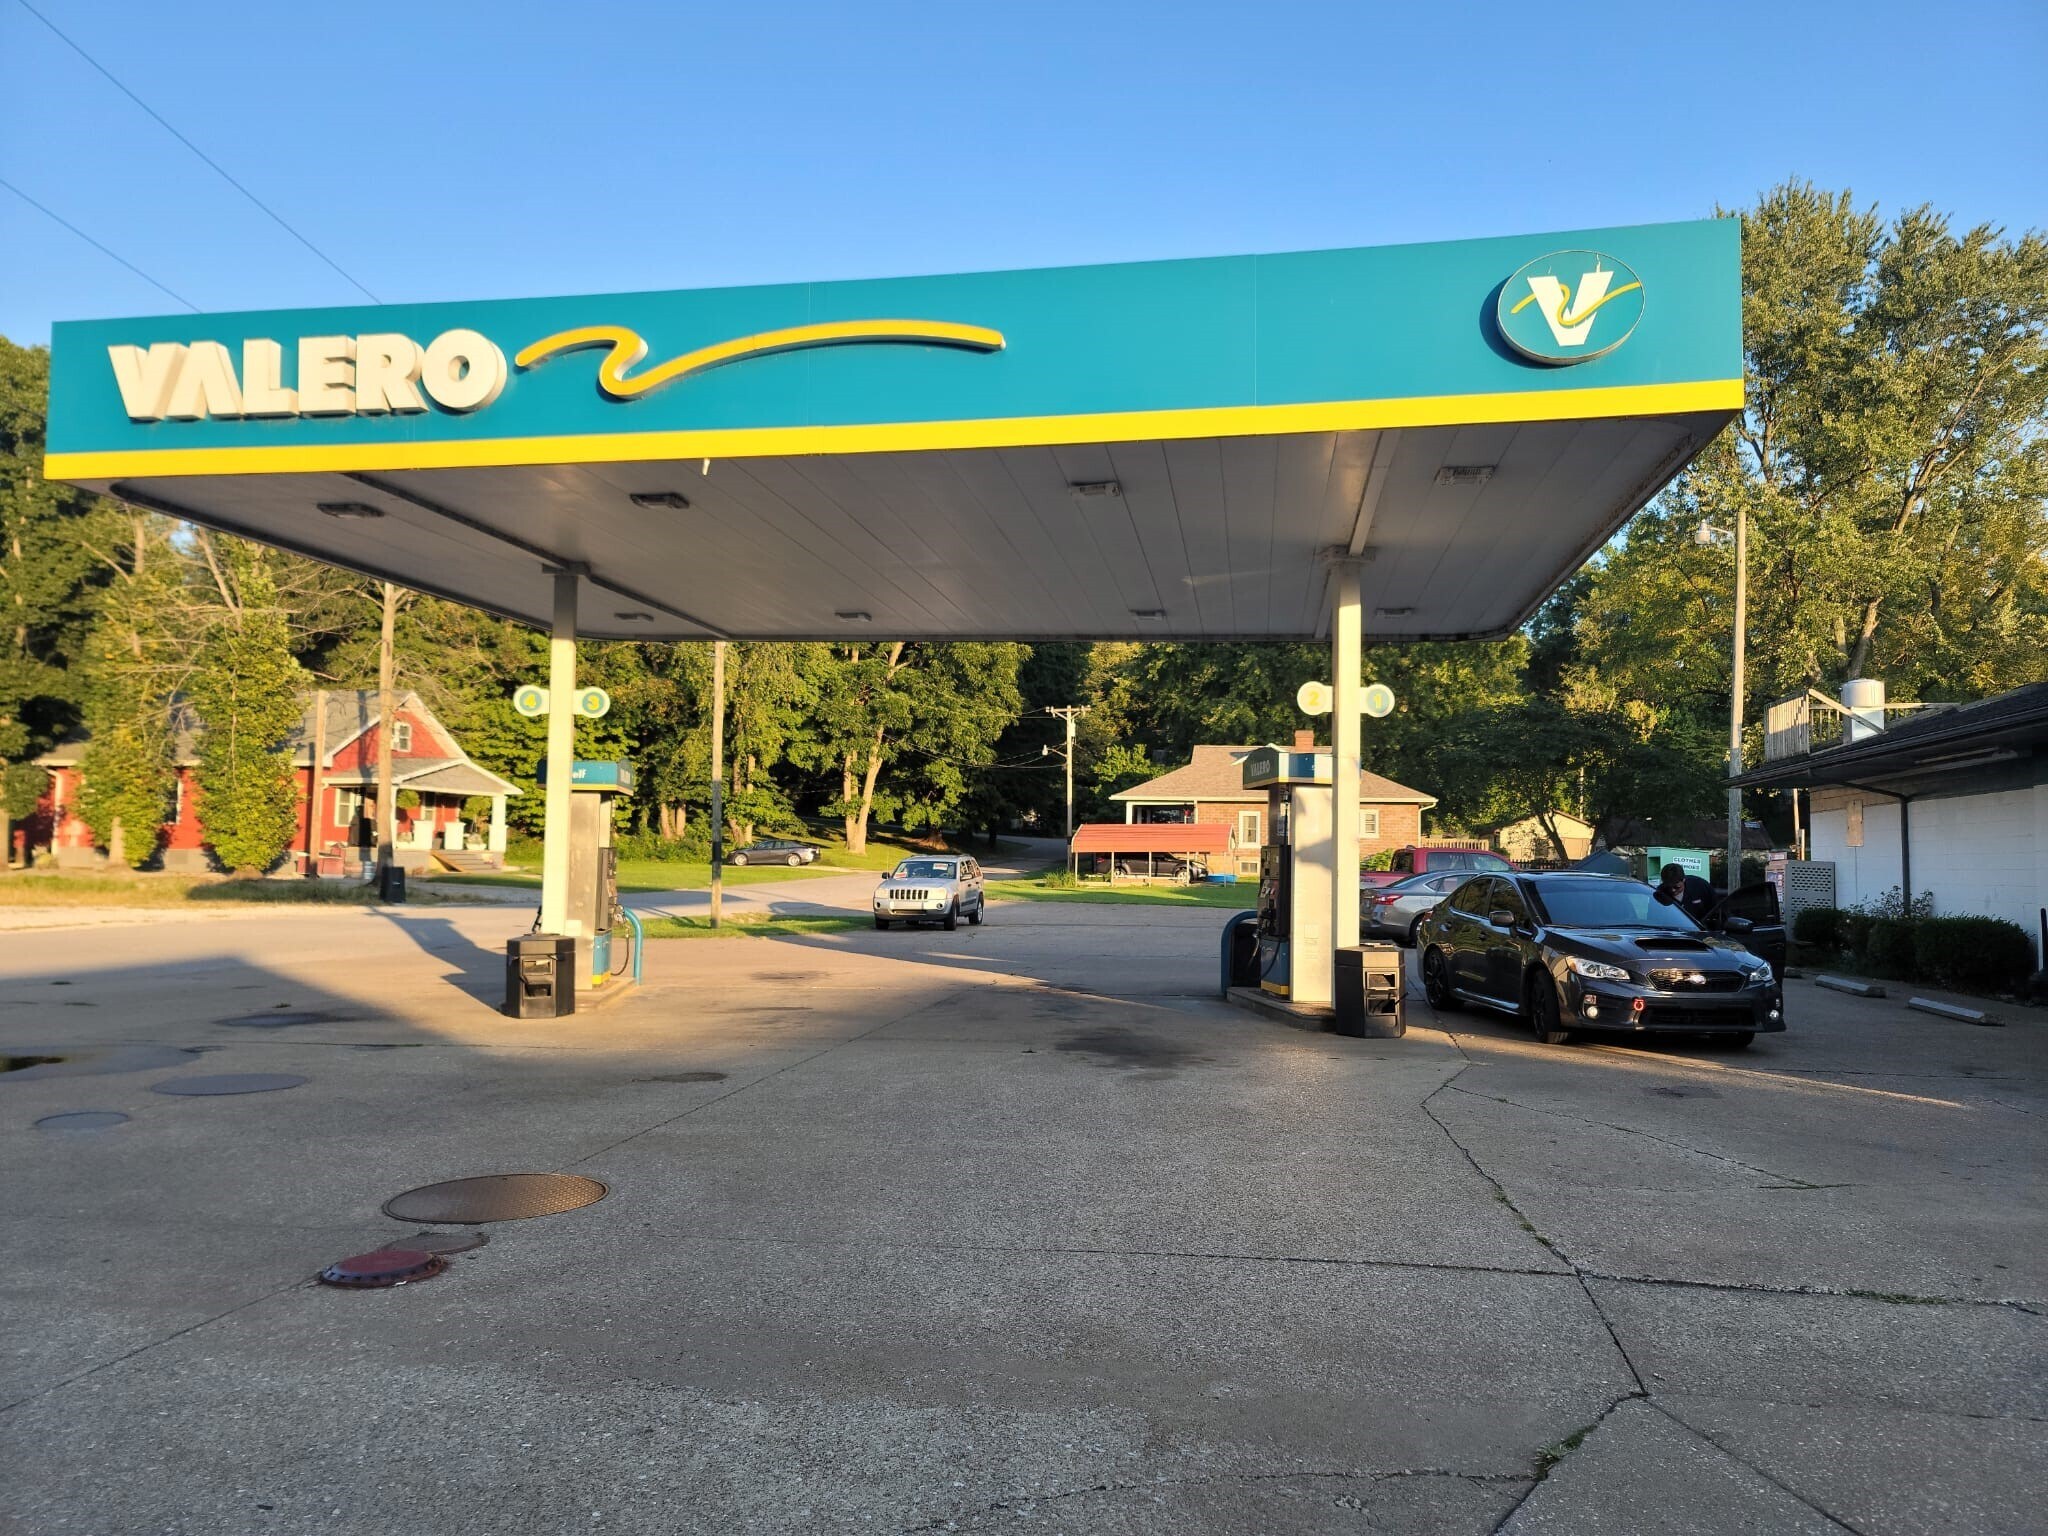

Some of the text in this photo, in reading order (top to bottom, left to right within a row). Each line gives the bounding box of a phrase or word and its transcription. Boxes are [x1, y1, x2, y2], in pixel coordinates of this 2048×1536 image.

[1527, 271, 1614, 347] V
[107, 328, 507, 419] VALERO
[524, 693, 537, 709] 4
[587, 694, 600, 711] 3
[1309, 691, 1320, 706] 2
[1373, 693, 1382, 709] 1
